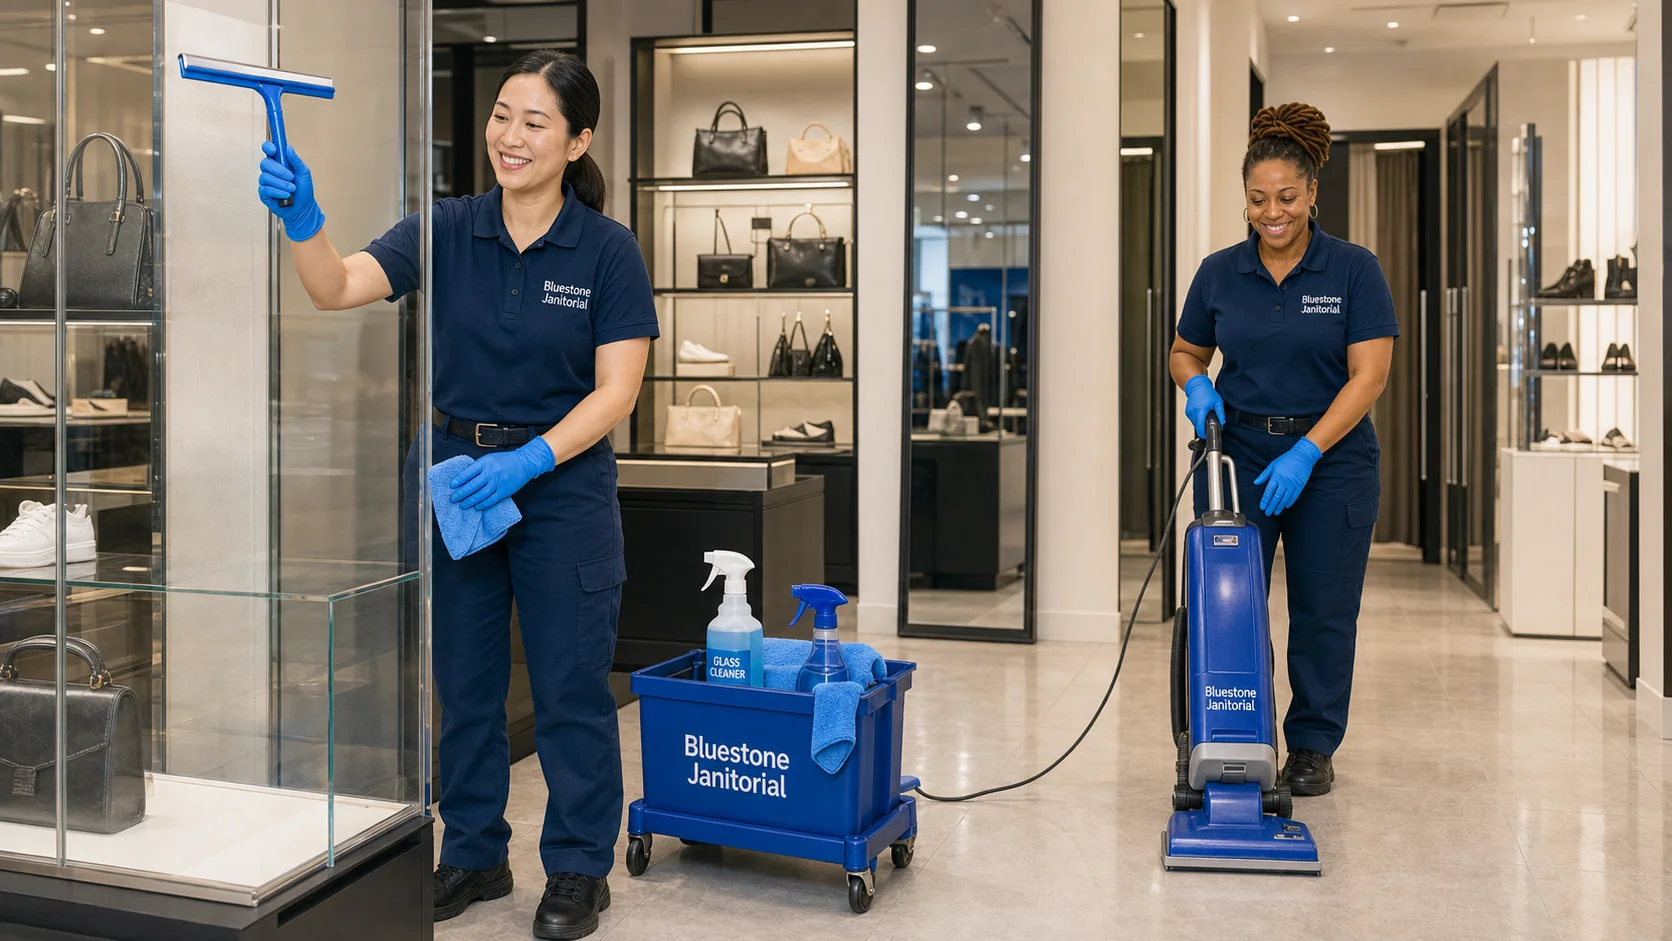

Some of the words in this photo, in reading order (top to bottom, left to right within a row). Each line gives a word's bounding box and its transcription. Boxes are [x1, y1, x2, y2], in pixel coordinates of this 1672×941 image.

[543, 280, 592, 298] Bluestone
[541, 292, 589, 310] Janitorial
[1301, 294, 1342, 304] Bluestone
[1300, 304, 1341, 314] Janitorial
[713, 655, 741, 668] GLASS
[709, 667, 746, 679] CLEANER
[1205, 685, 1257, 699] Bluestone
[1206, 698, 1256, 712] Janitorial
[684, 733, 790, 771] Bluestone
[687, 762, 787, 799] Janitorial
